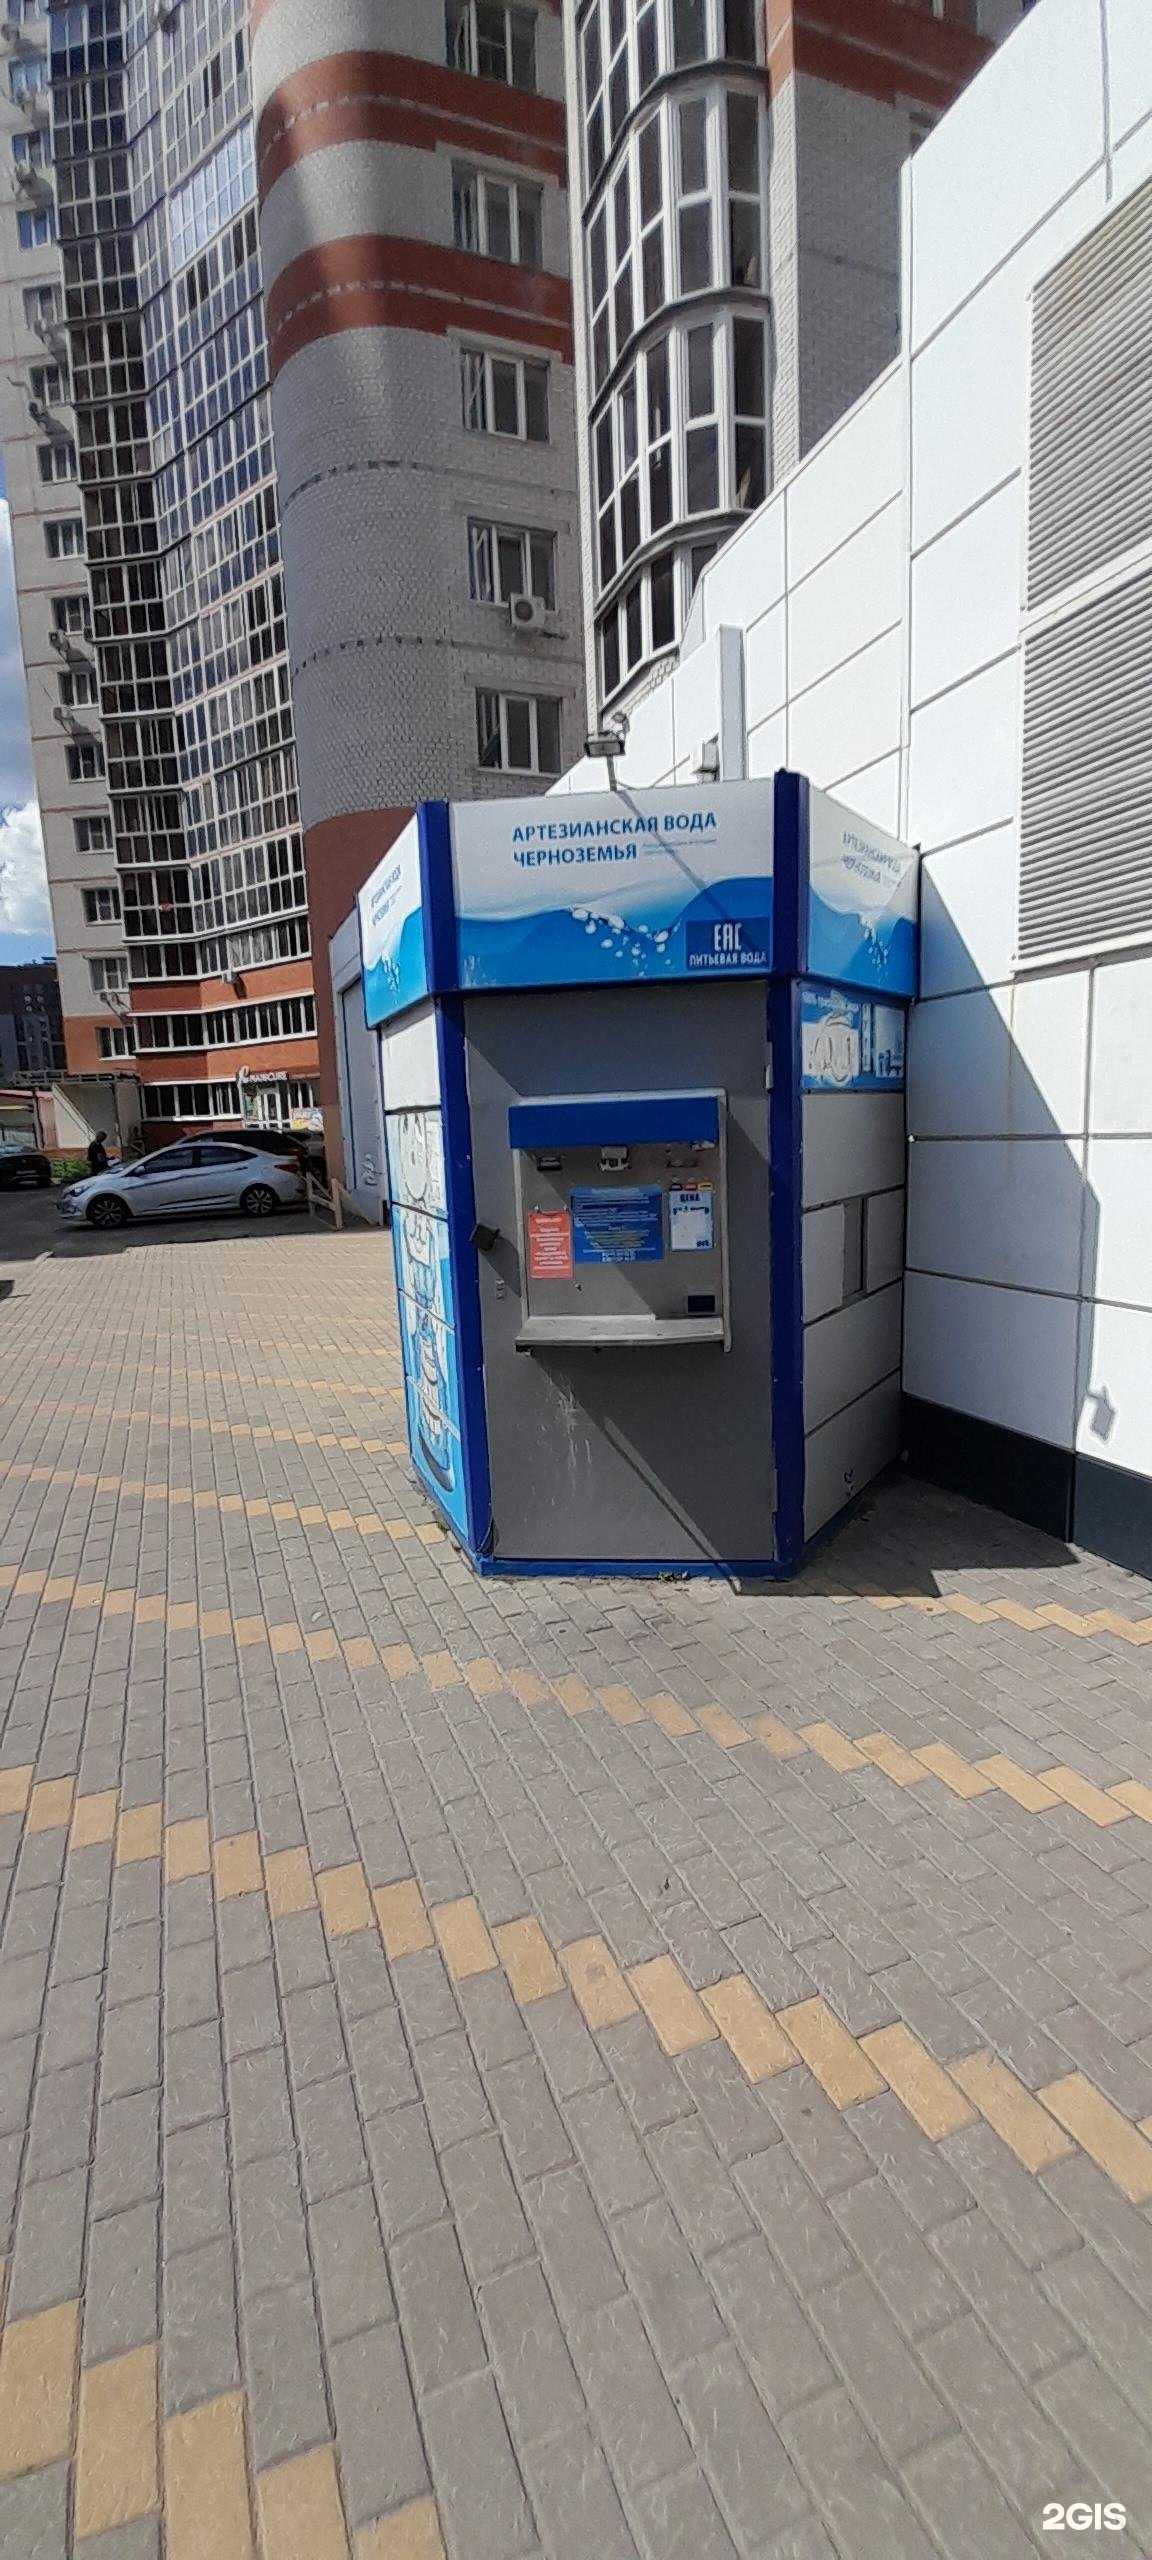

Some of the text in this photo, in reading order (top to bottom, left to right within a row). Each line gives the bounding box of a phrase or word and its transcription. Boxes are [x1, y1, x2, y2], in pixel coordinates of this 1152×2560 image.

[512, 812, 717, 842] АРТЕЗИАНСКАЯ ВОДА
[513, 843, 637, 868] ЧЕРНОЗЕМЬЯ
[689, 951, 767, 967] ПИТЬЕВАЯ ВОДА
